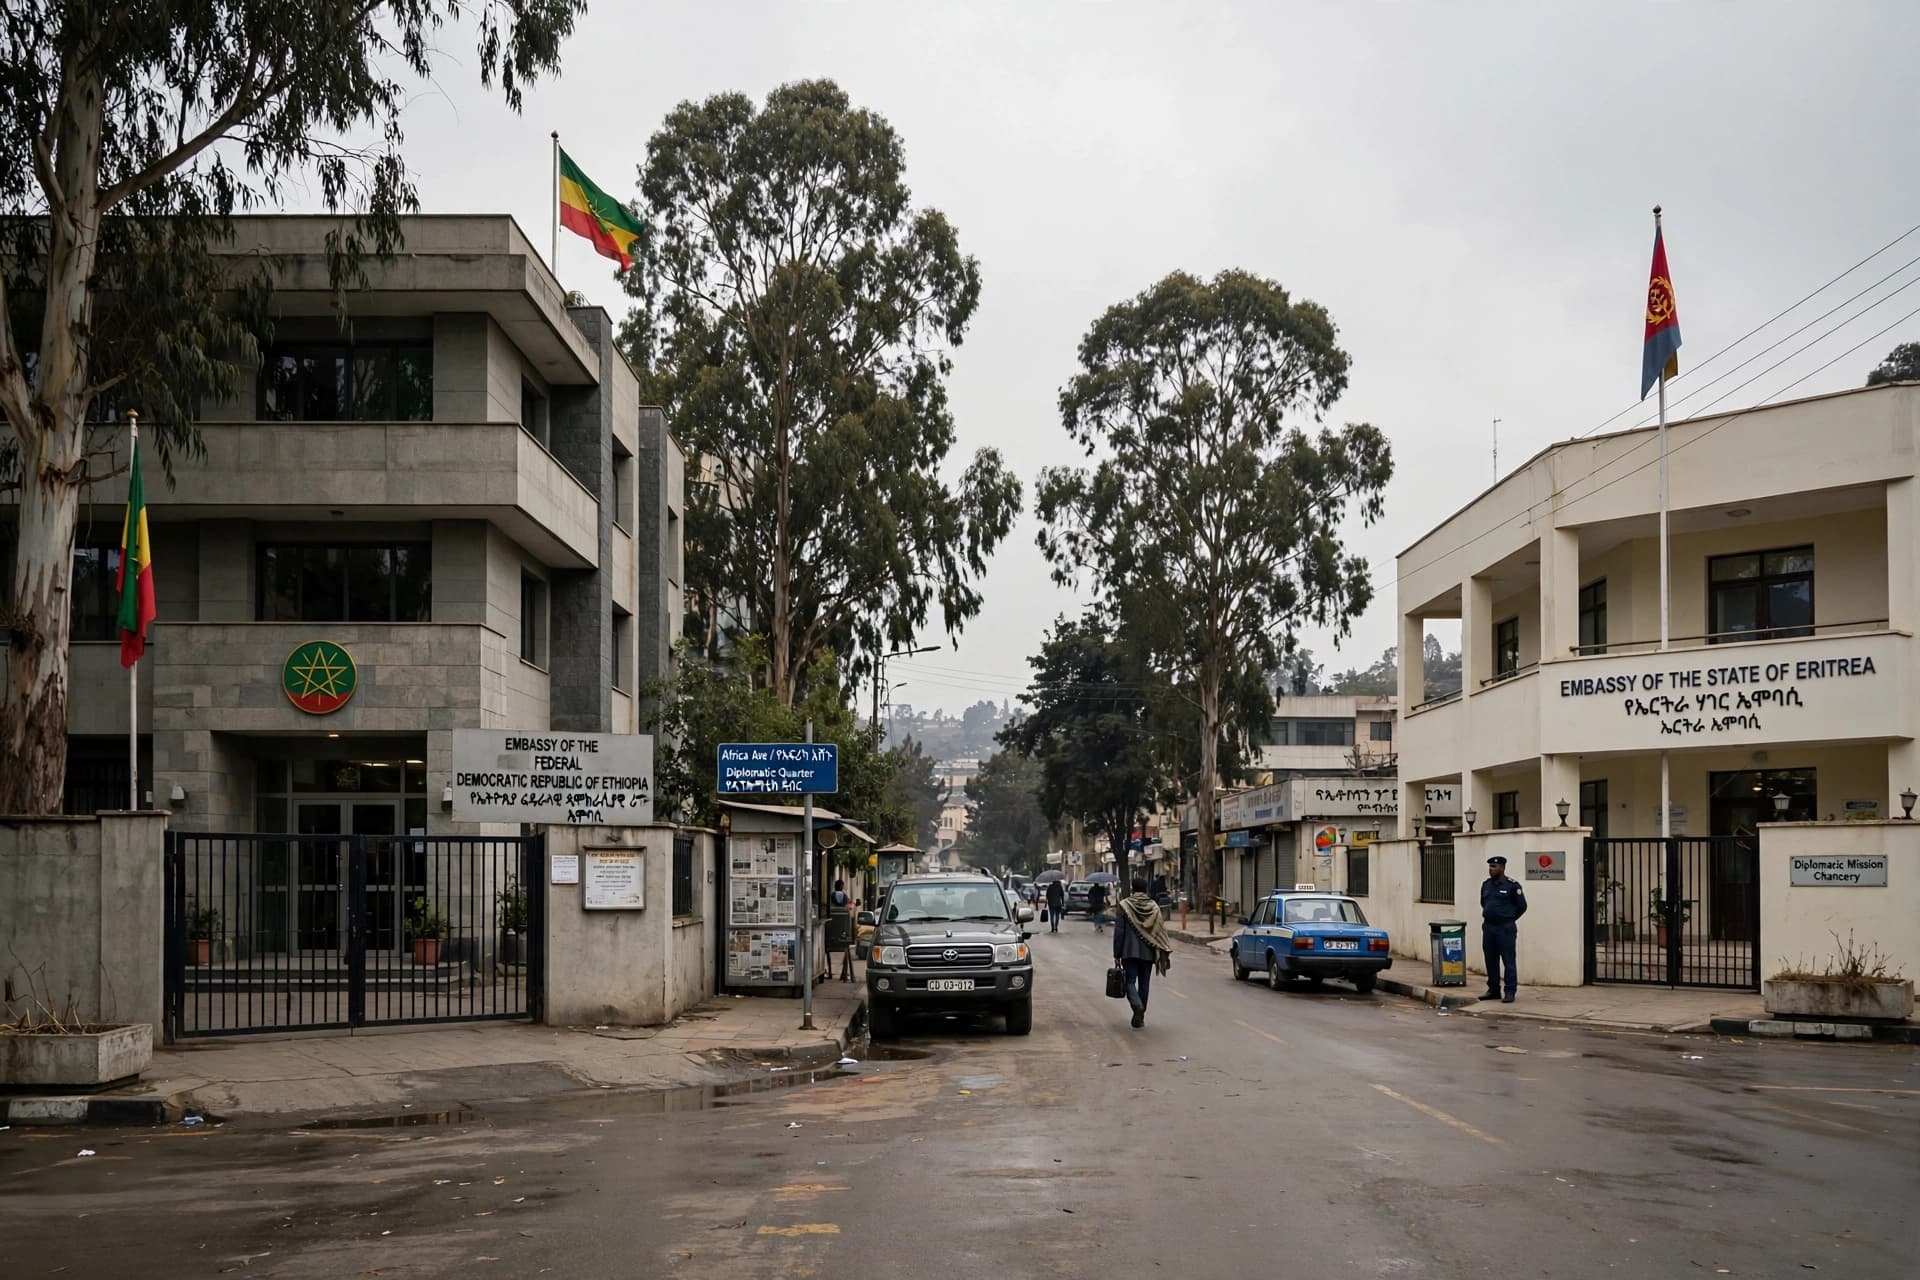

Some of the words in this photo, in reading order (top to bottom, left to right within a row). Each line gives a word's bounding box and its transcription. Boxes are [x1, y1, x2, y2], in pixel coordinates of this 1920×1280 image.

[1560, 674, 1637, 697] EMBASSY
[1642, 673, 1664, 690] OF
[1669, 670, 1702, 689] THE
[1707, 665, 1760, 686] STATE
[1766, 663, 1790, 681] OF
[1796, 656, 1877, 680] ERITREA
[505, 738, 558, 752] EMBASSY
[560, 739, 575, 752] OF
[577, 740, 599, 753] THE
[721, 749, 749, 761] Africa
[751, 750, 768, 761] Ave
[534, 756, 583, 771] FEDERAL
[726, 767, 777, 780] Diplomatic
[778, 767, 815, 779] Quarter
[456, 772, 528, 789] DEMOCRATIC
[530, 774, 583, 790] REPUBLIC
[585, 776, 600, 790] OF
[602, 777, 649, 791] ETHIOPIA
[1847, 858, 1884, 869] Mission
[1813, 871, 1861, 884] Chancery
[929, 980, 940, 990] CD
